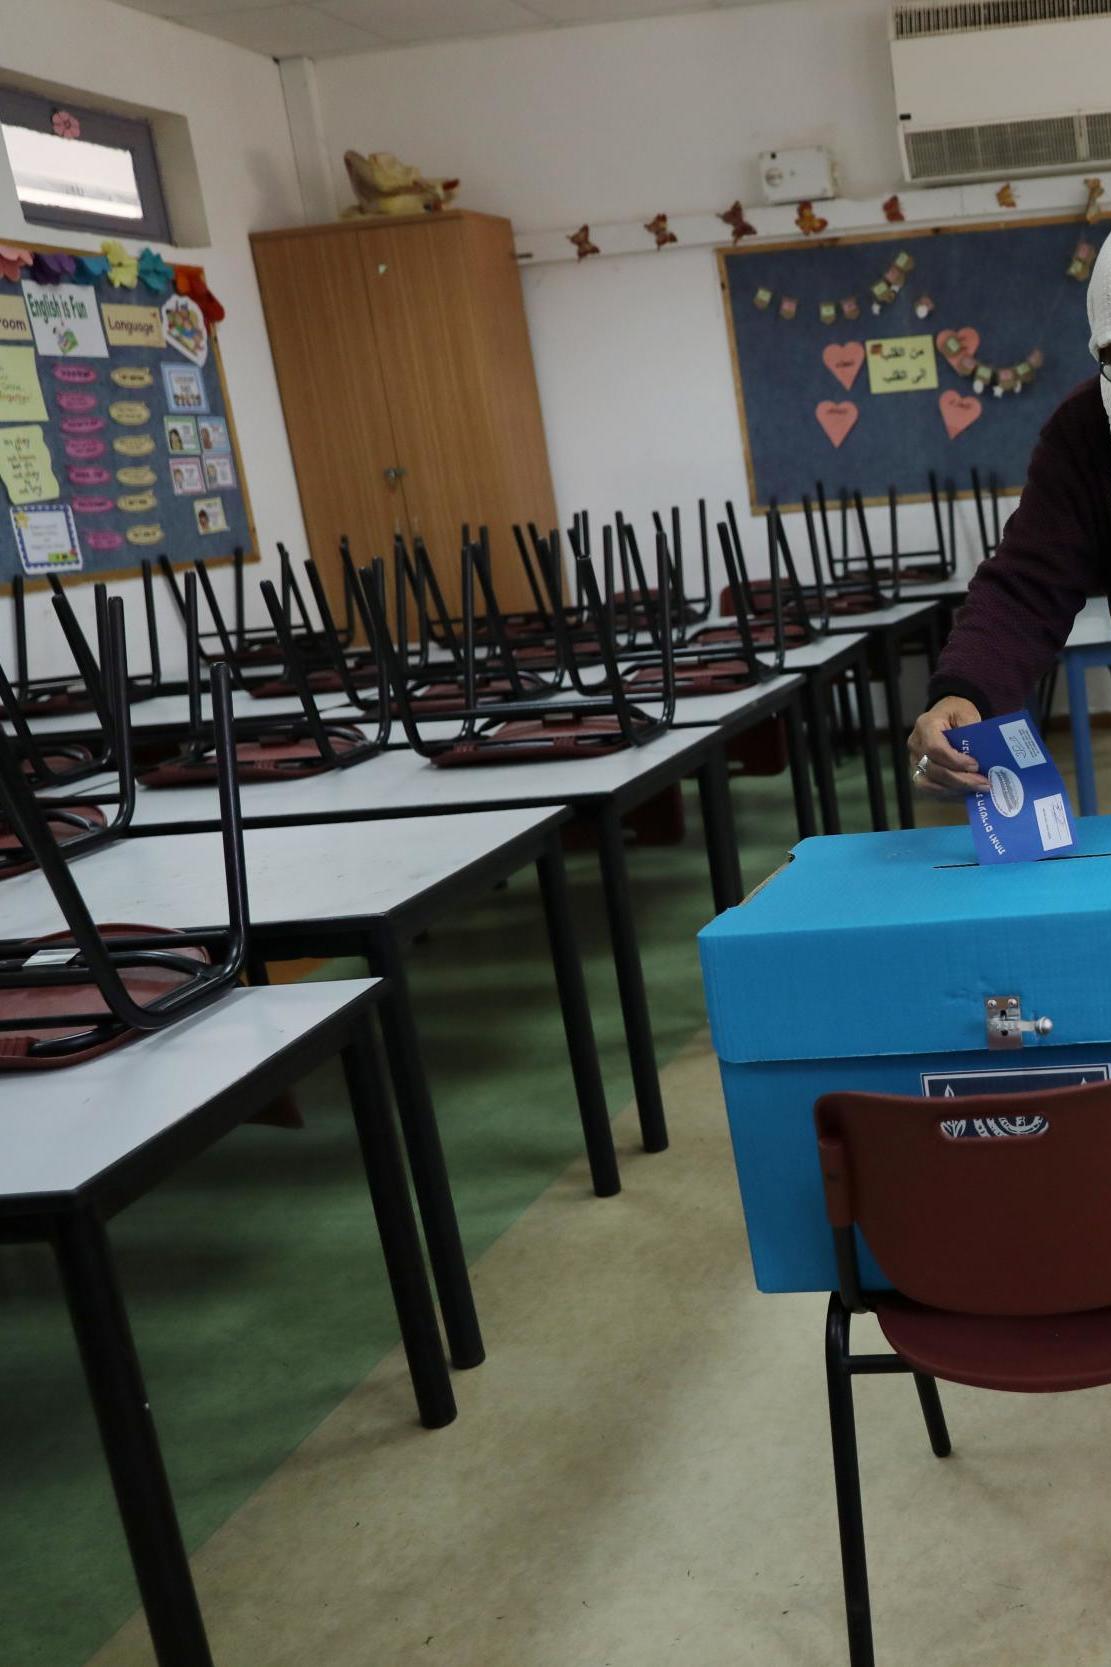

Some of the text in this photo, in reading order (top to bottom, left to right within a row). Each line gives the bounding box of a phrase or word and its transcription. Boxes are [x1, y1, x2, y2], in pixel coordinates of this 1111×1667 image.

[27, 293, 61, 324] English
[69, 295, 88, 318] Fun
[107, 315, 154, 336] Language
[977, 800, 993, 833] העשרים
[989, 833, 1006, 855] ואחת
